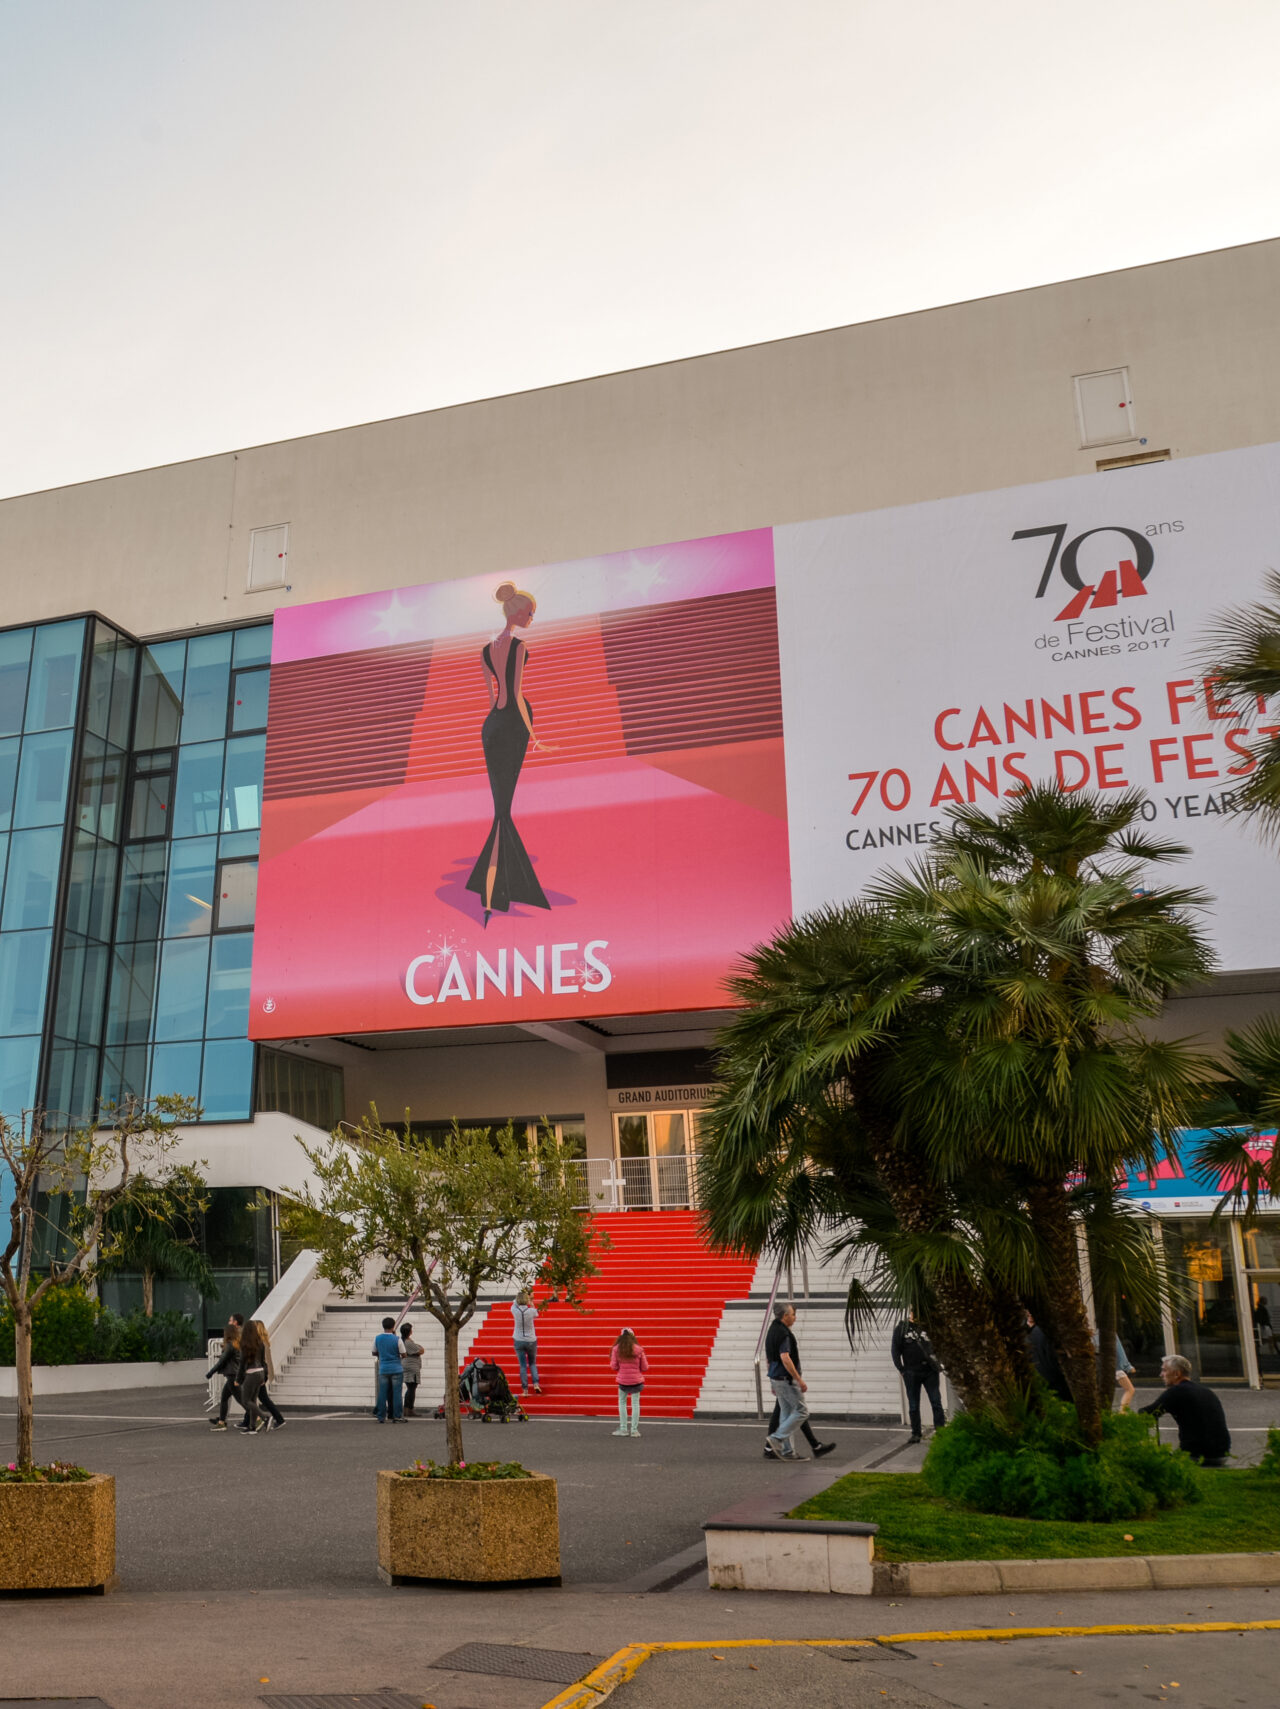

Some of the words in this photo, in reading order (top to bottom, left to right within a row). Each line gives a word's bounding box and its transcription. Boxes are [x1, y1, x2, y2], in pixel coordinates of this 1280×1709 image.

[1011, 523, 1154, 599] 70
[1145, 520, 1185, 537] ans
[1034, 634, 1060, 650] de
[1067, 609, 1175, 645] Festival
[1051, 644, 1121, 662] CANNES
[1127, 637, 1171, 653] 2017
[934, 686, 1142, 751] CANNES
[848, 768, 911, 816] 70
[929, 751, 1032, 807] ANS
[1054, 743, 1129, 793] DE
[846, 821, 942, 851] CANNES
[405, 939, 612, 1005] CANNES
[618, 1090, 651, 1104] GRAND
[654, 1087, 716, 1102] AUDITORIUM
